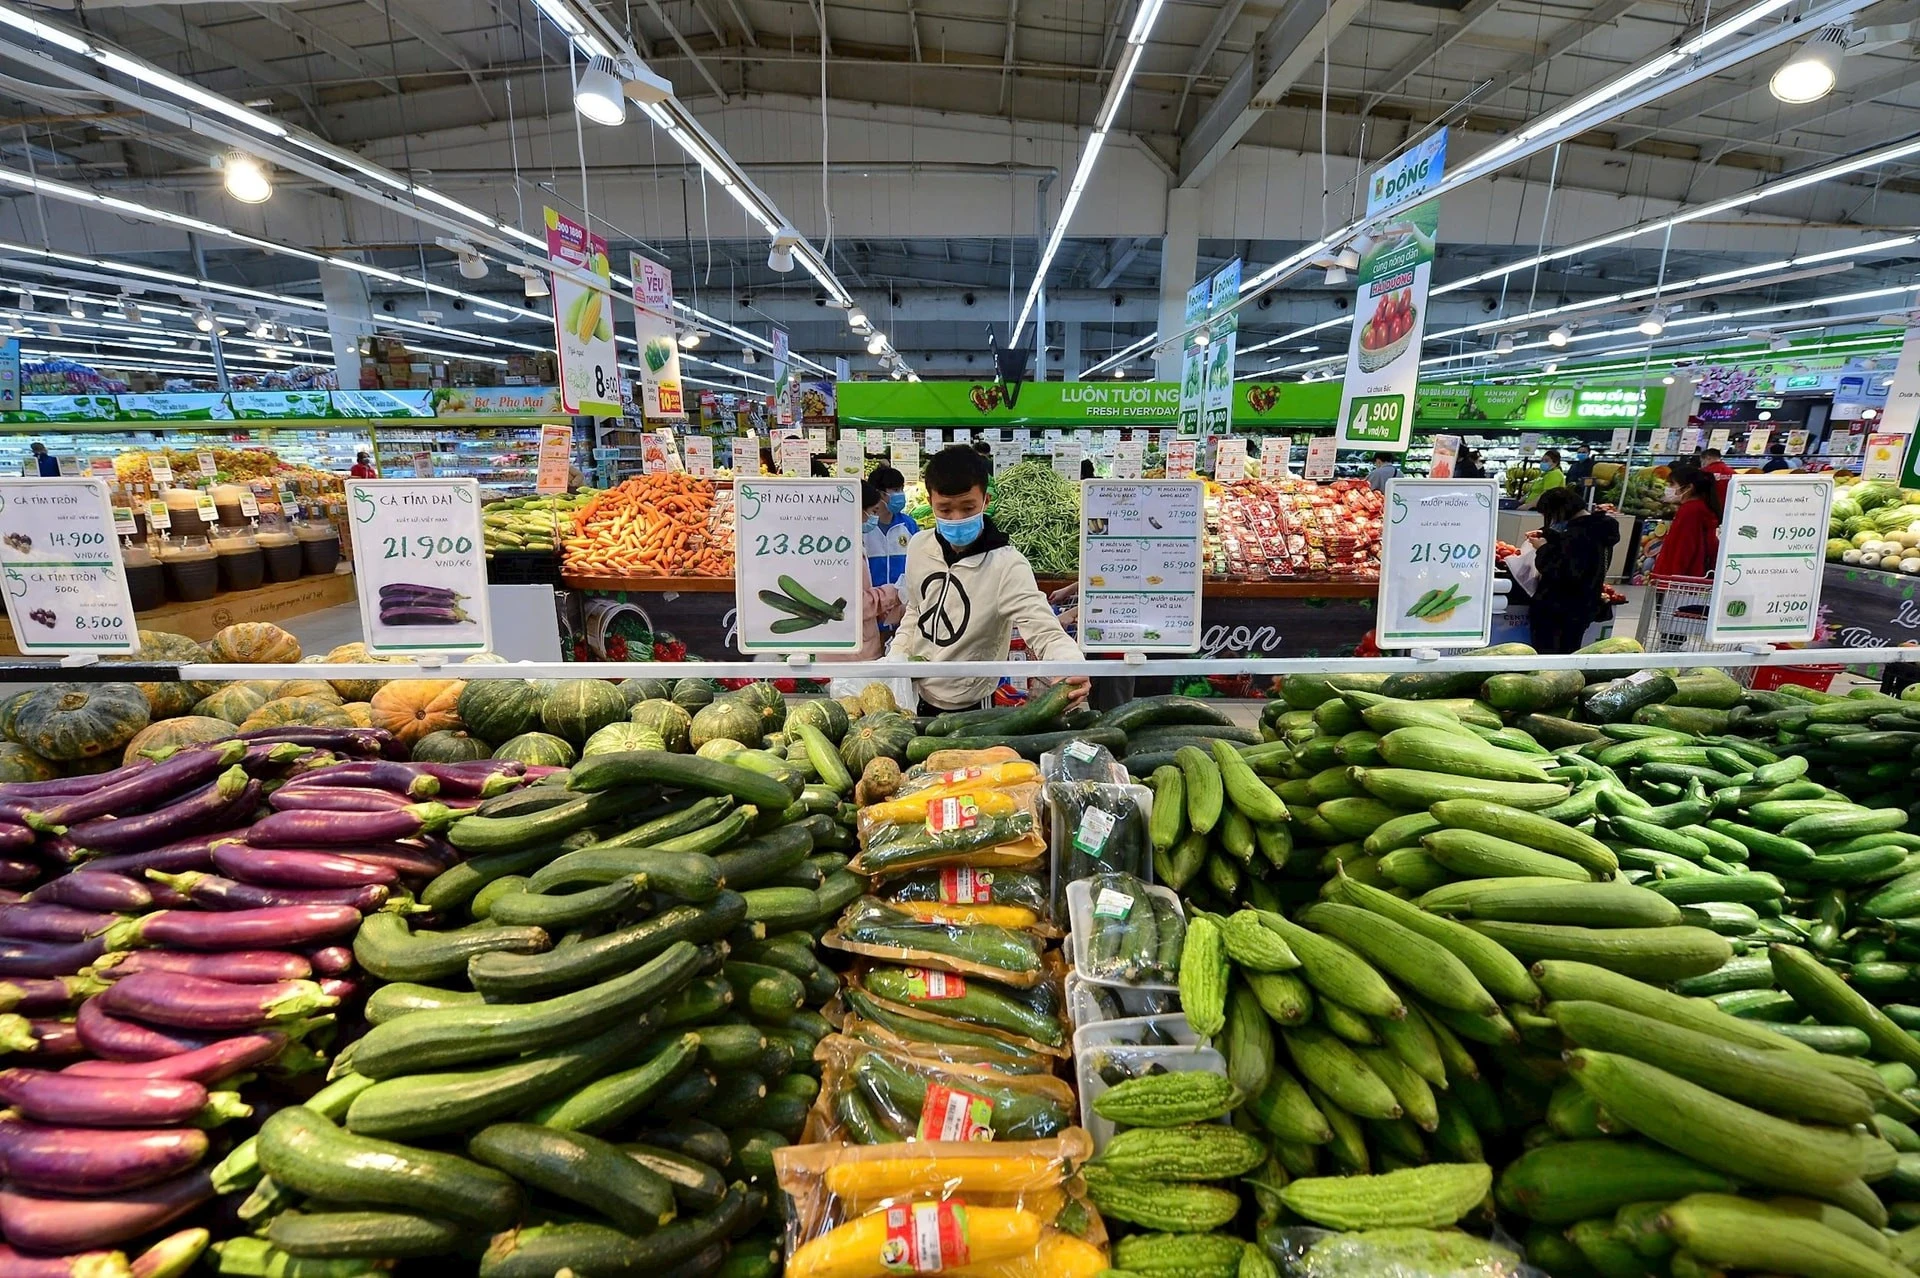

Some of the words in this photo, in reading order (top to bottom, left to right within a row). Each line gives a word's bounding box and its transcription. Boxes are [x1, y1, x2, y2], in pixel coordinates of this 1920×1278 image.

[1062, 385, 1108, 403] LUÔN
[1112, 388, 1150, 404] TƯƠI
[1086, 406, 1120, 416] FRESH
[1123, 406, 1178, 416] EVERYDAY
[1578, 404, 1647, 418] ORGANIC
[402, 492, 428, 505] TÍM
[760, 490, 771, 503] BÍ
[775, 491, 804, 504] NGÒI
[808, 494, 840, 504] XANH
[1106, 510, 1139, 518] 44.900
[1168, 510, 1197, 518] 27.900
[50, 532, 104, 547] 14.900
[1772, 526, 1816, 540] 19.900
[383, 536, 472, 559] 21.900
[756, 534, 851, 556] 23.800
[1410, 543, 1481, 564] 21.900
[1100, 564, 1138, 573] 63.900
[1163, 561, 1196, 569] 85.900
[55, 586, 80, 594] 500G
[1109, 607, 1138, 615] 16.200
[1766, 601, 1808, 614] 21.900
[76, 616, 123, 630] 8.500
[1165, 620, 1194, 628] 22.900
